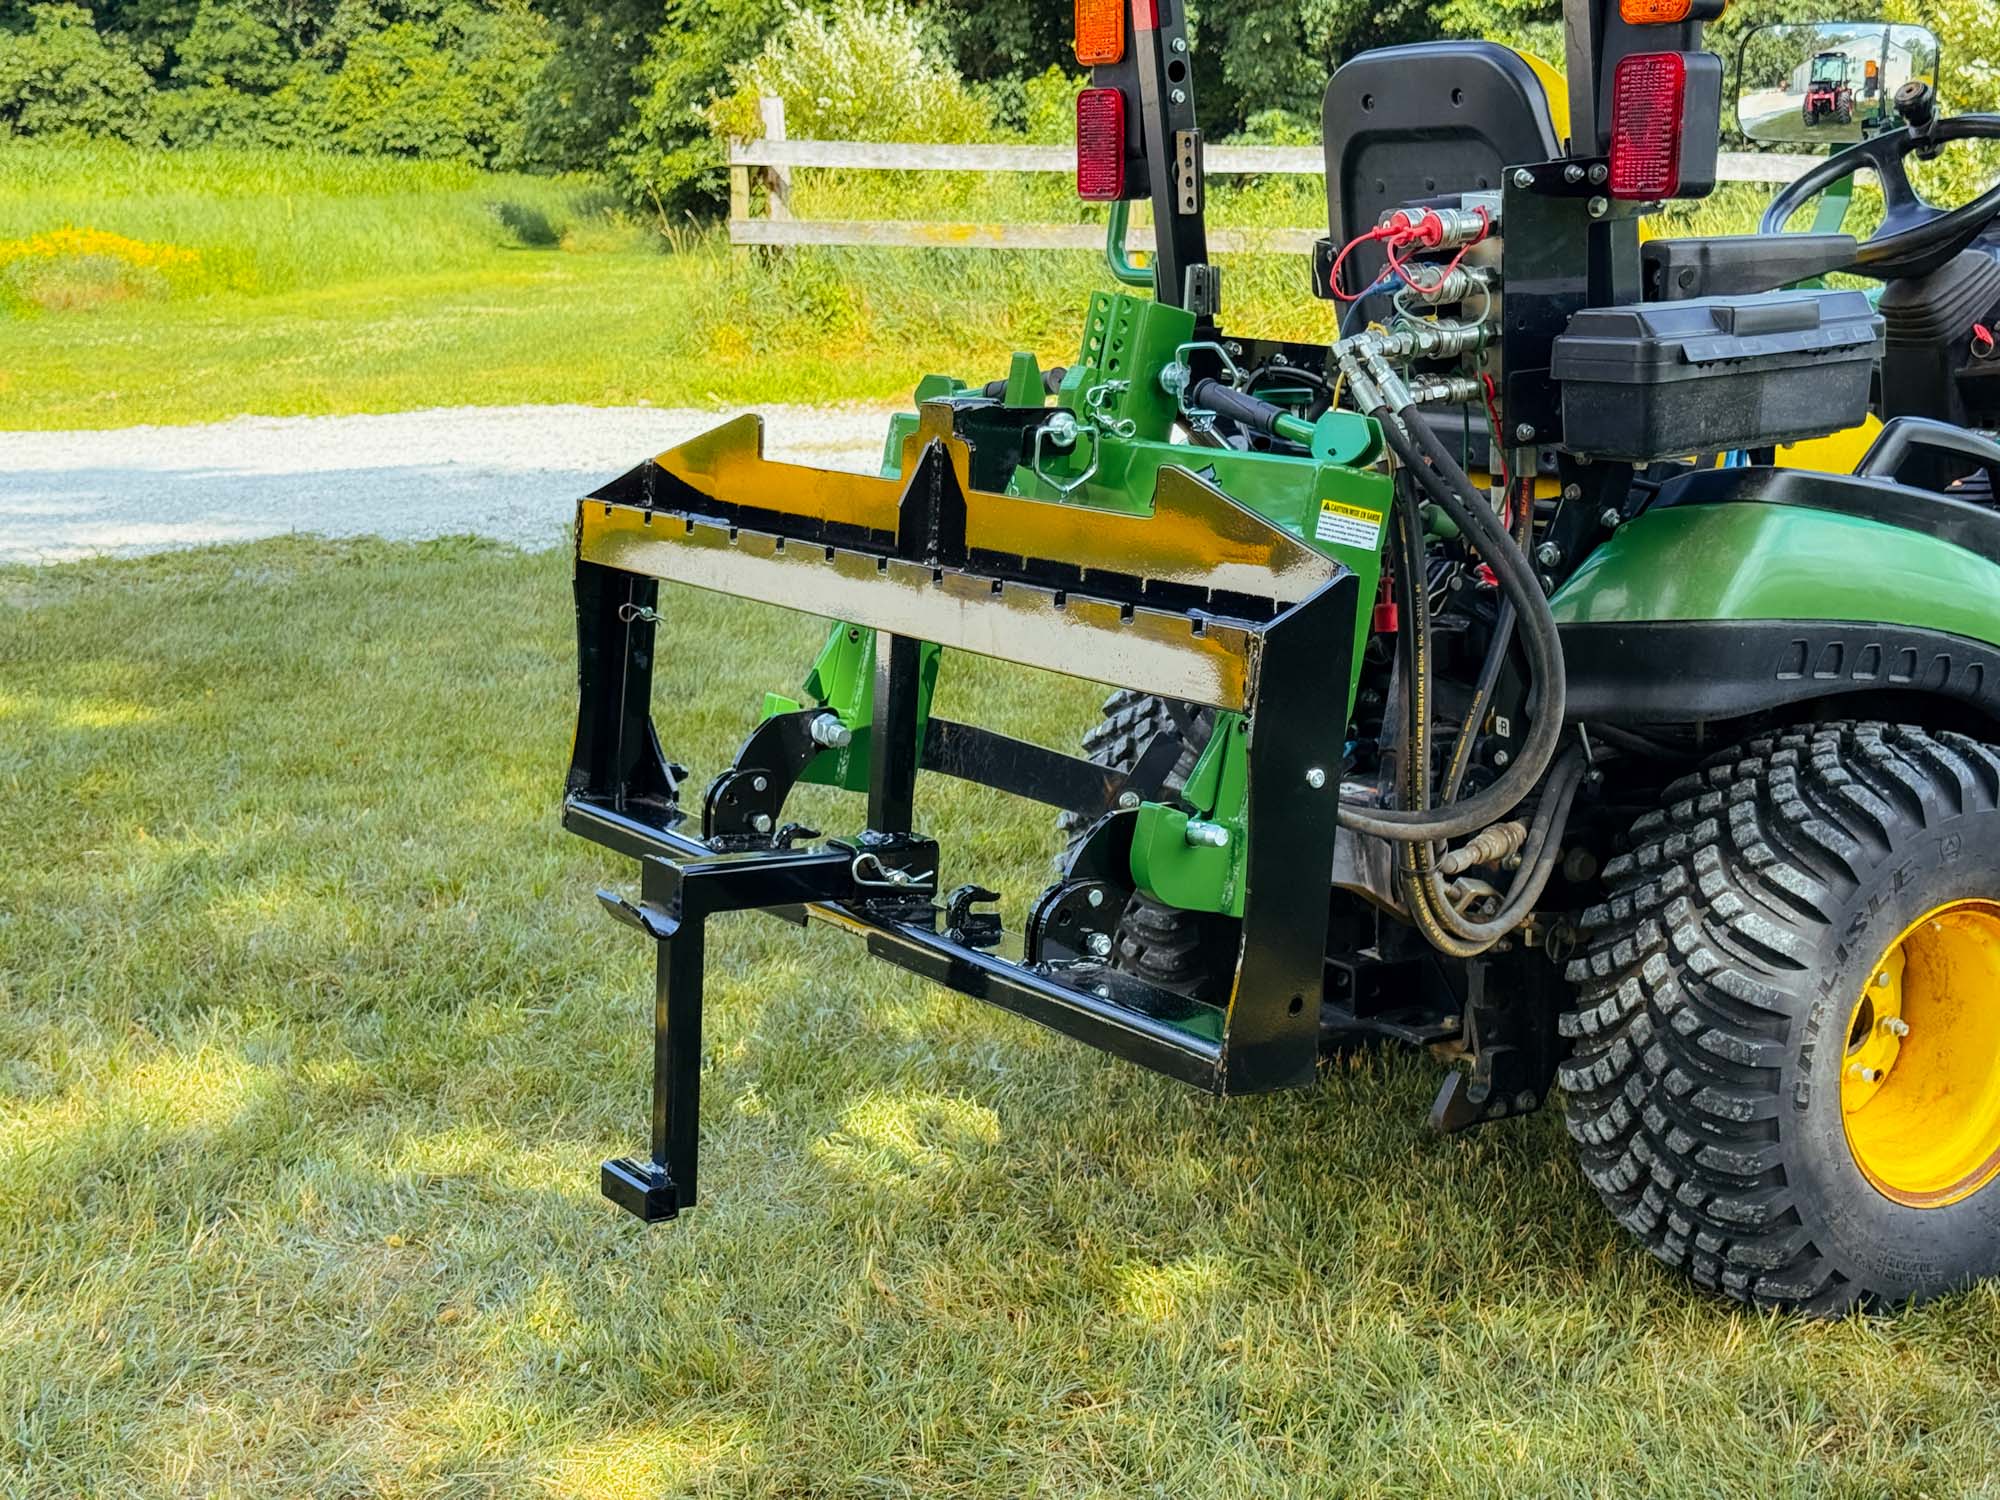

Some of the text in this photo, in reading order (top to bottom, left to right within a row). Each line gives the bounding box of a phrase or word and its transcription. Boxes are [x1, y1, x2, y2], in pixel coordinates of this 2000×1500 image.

[1331, 504, 1348, 513] CAUTION
[1366, 512, 1380, 522] GARDE
[1416, 726, 1424, 754] FLAME
[1792, 860, 1916, 1113] CARLISLE
